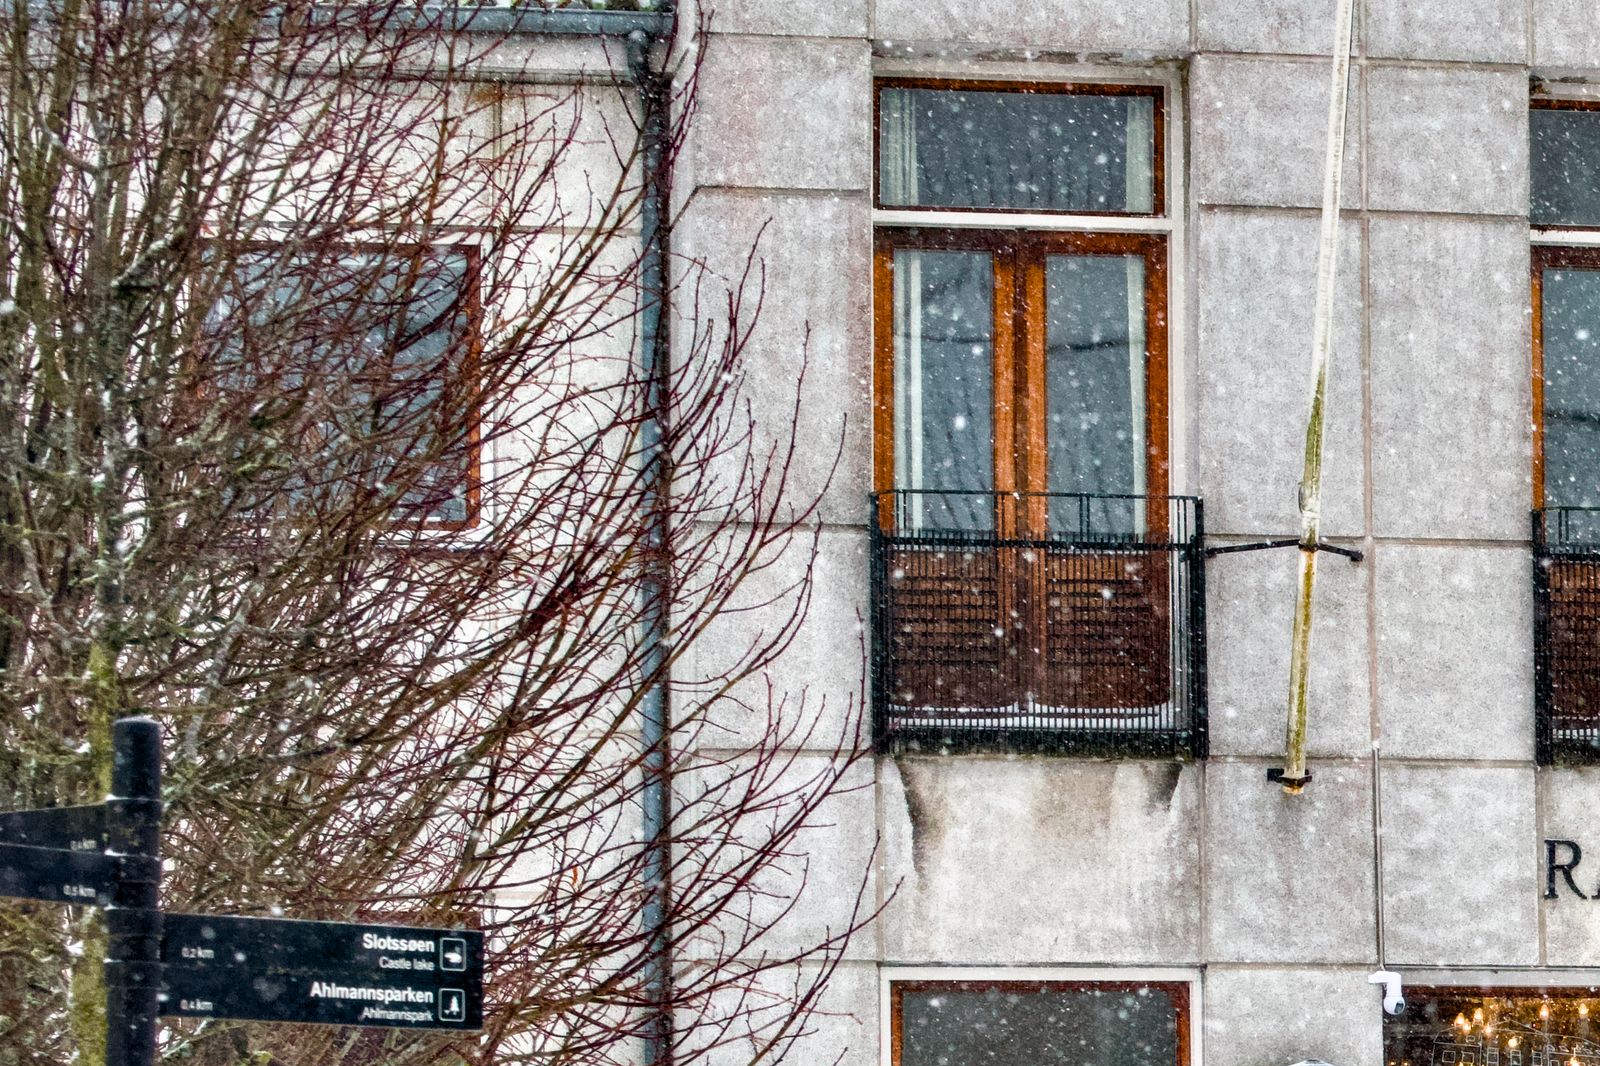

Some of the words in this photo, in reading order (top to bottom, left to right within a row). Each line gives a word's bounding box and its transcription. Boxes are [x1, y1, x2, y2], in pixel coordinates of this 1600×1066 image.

[362, 933, 435, 952] Slotssøen
[380, 956, 412, 970] Castle
[413, 958, 435, 971] lake
[310, 981, 434, 1004] Ahlmannsparken
[362, 1007, 434, 1023] Ahlmannspark
